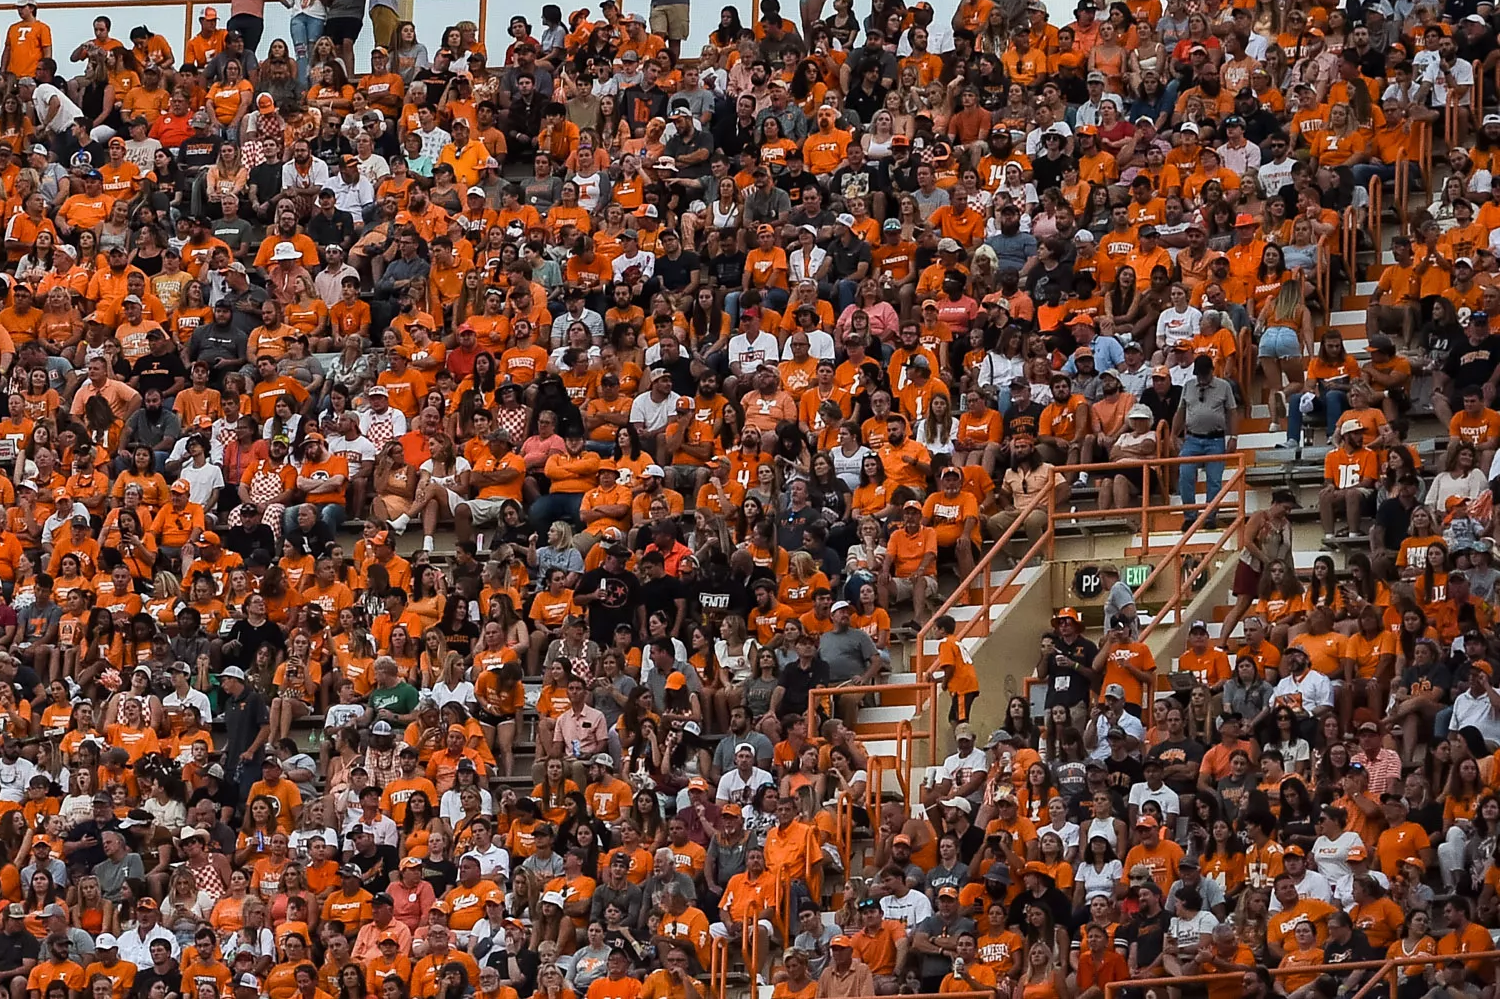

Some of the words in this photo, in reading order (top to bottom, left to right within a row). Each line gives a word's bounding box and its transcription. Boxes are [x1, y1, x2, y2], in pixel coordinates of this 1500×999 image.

[18, 27, 32, 40] T
[1471, 435, 1481, 445] T
[1339, 464, 1360, 489] 16
[1082, 575, 1100, 592] PP
[1127, 567, 1148, 585] EXIT
[594, 793, 613, 812] T
